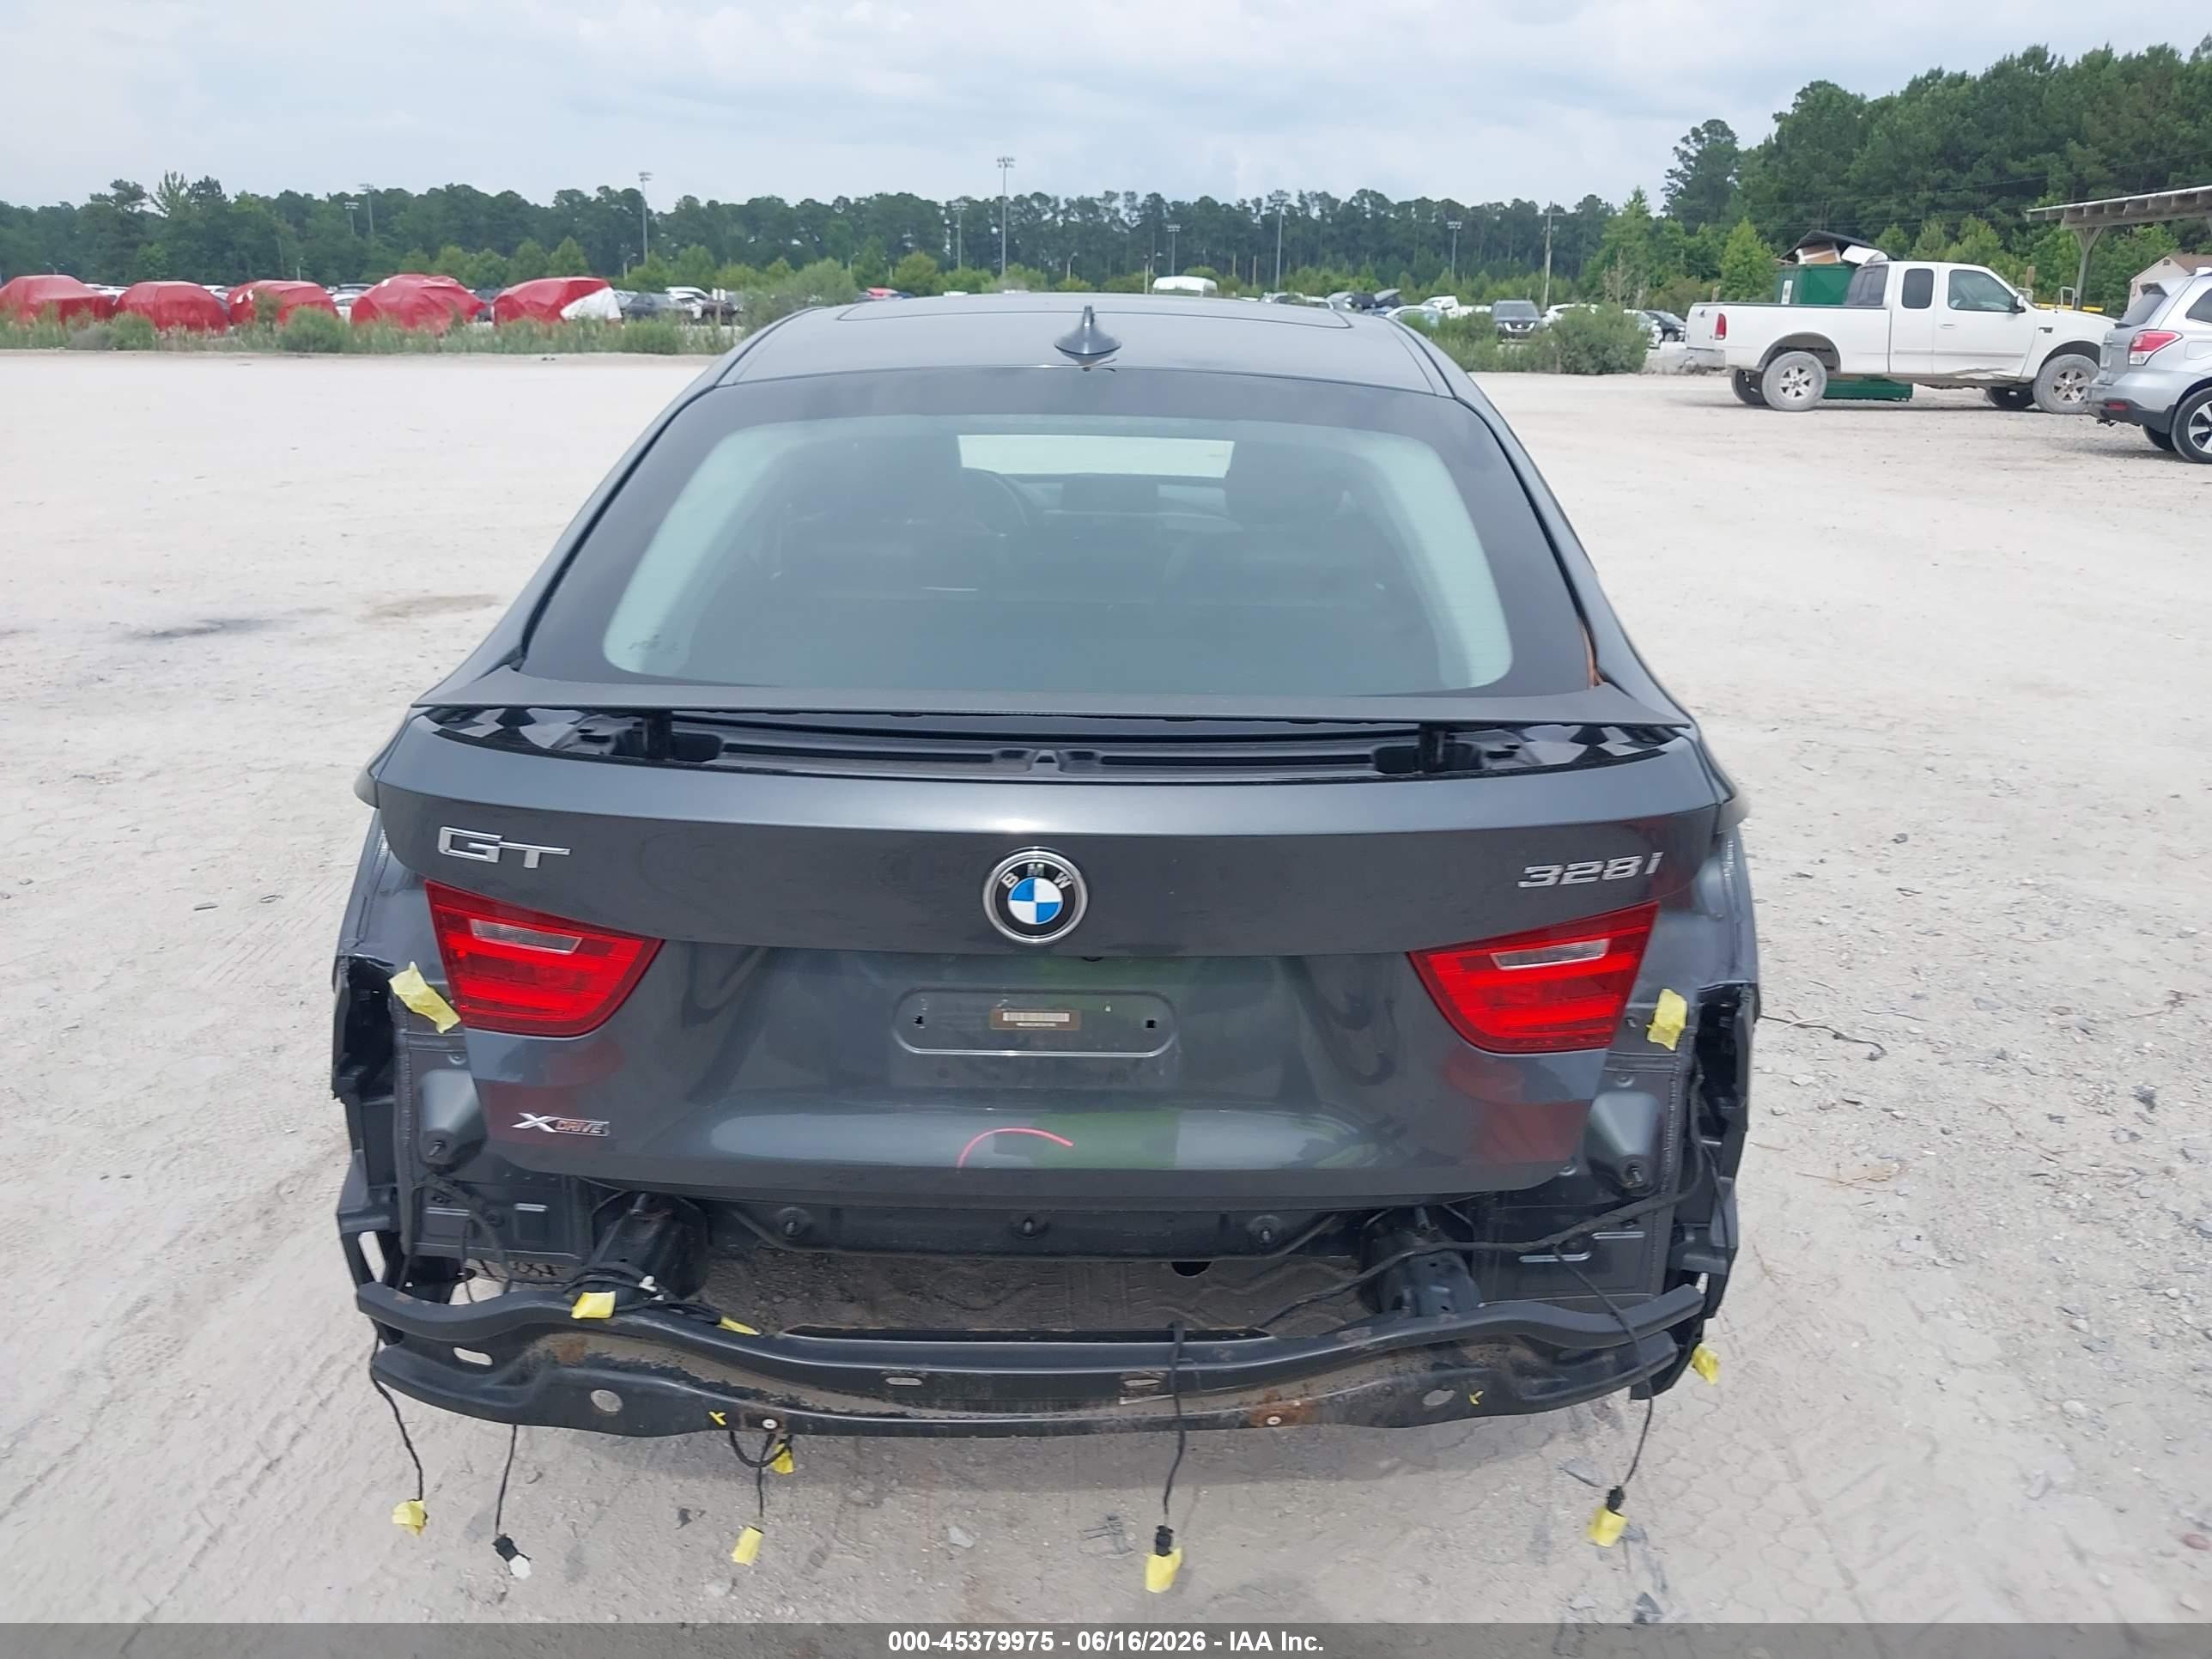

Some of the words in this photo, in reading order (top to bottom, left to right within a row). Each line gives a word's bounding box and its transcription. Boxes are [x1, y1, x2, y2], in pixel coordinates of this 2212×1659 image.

[438, 826, 571, 868] GT
[1000, 862, 1073, 889] BMW
[1517, 851, 1664, 888] 328i
